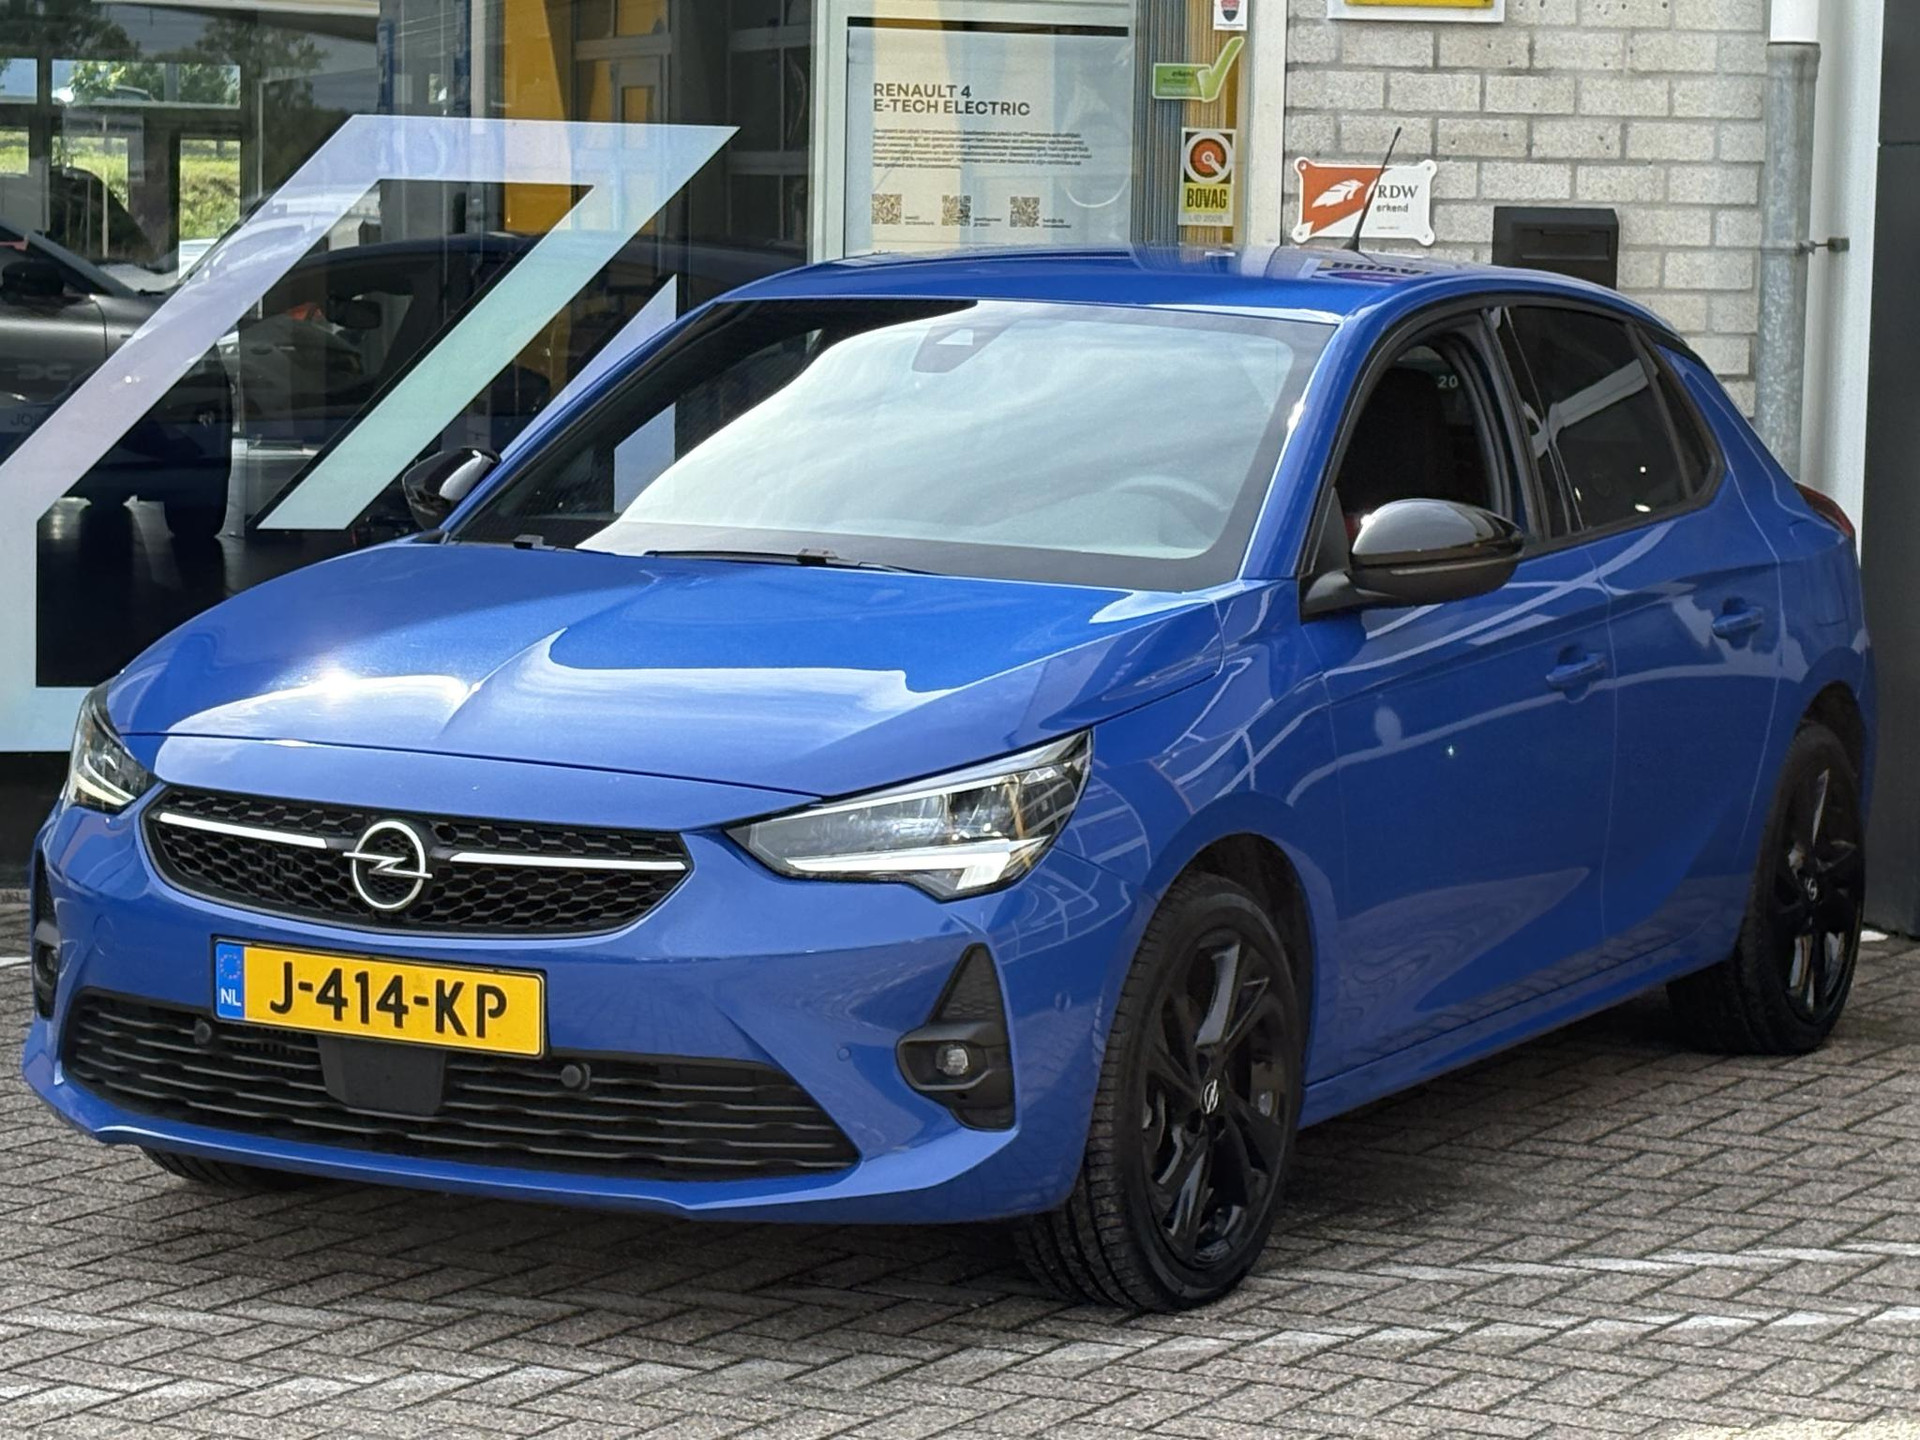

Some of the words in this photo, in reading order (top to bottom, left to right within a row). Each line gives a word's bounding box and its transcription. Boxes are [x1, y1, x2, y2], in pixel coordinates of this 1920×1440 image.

[873, 82, 957, 98] RENAULT
[961, 85, 972, 99] 4
[873, 98, 939, 114] E-TECH
[943, 99, 1031, 116] ELECTRIC
[1186, 187, 1227, 209] BOVAG
[1377, 184, 1419, 199] RDW
[1376, 203, 1409, 213] erkend
[1437, 375, 1459, 388] 20
[220, 988, 242, 1007] NL
[270, 961, 507, 1039] J-414-KP
